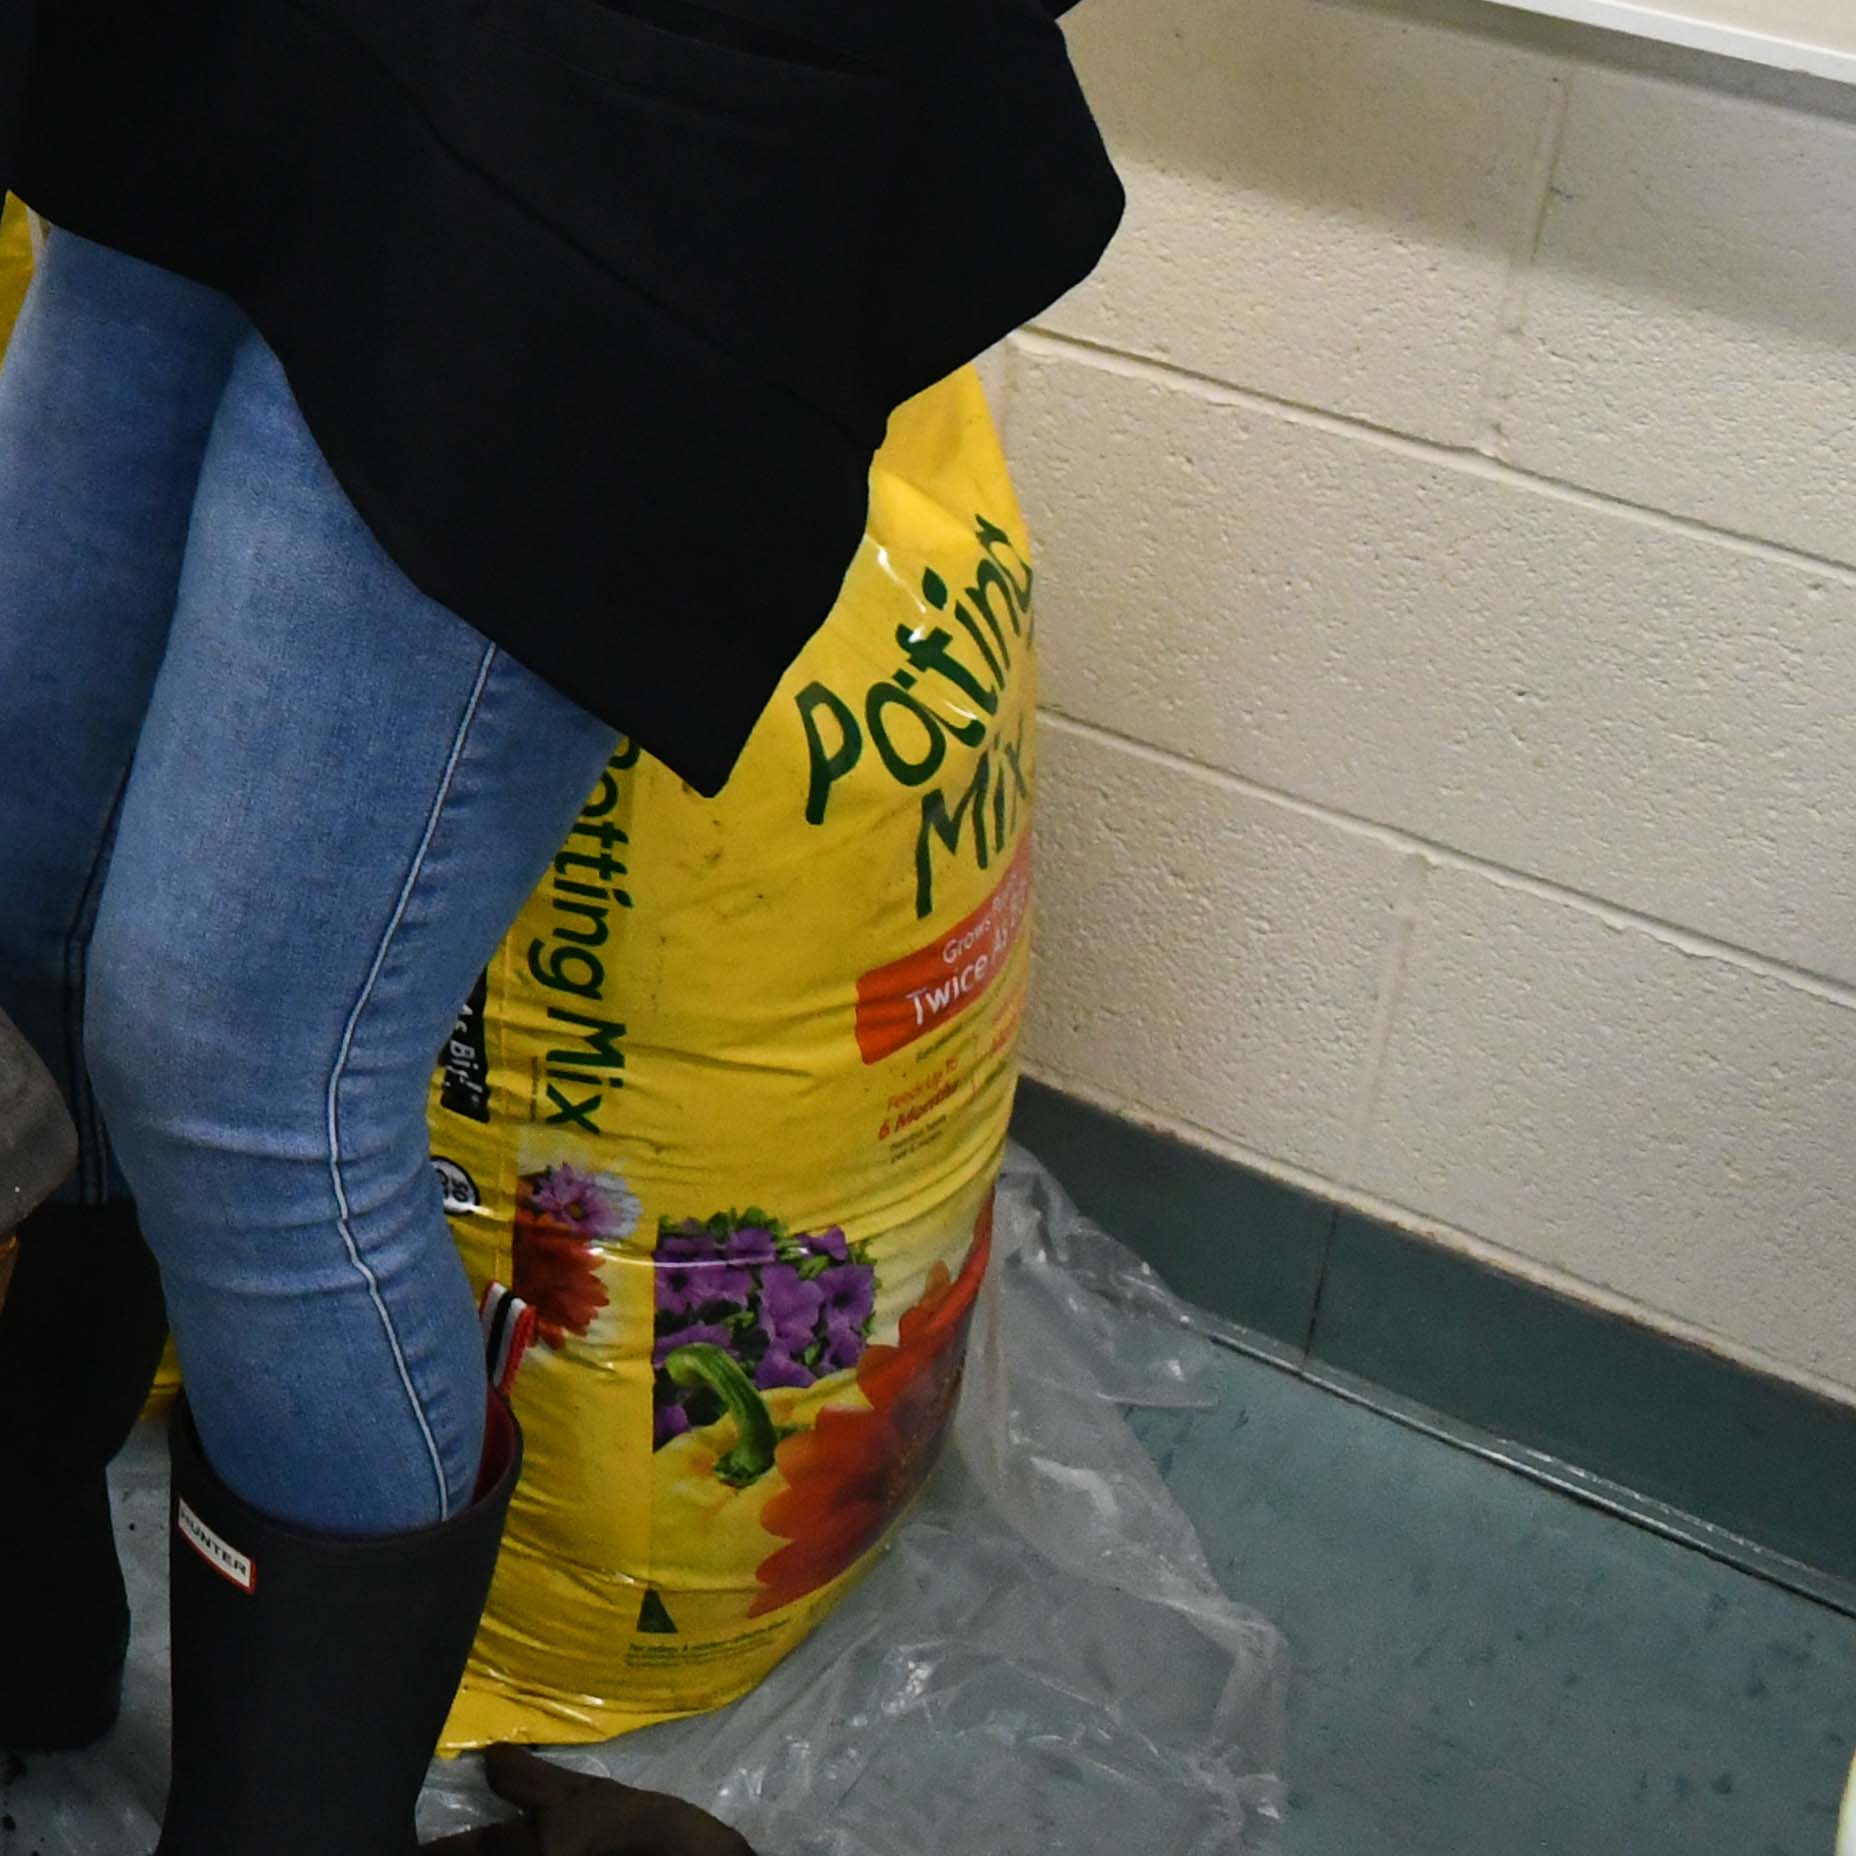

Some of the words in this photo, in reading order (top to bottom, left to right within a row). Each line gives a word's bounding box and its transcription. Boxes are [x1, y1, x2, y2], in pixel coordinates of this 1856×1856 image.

[905, 953, 989, 1028] Twice
[545, 1007, 629, 1136] Mix
[180, 1508, 248, 1577] HUNTER
